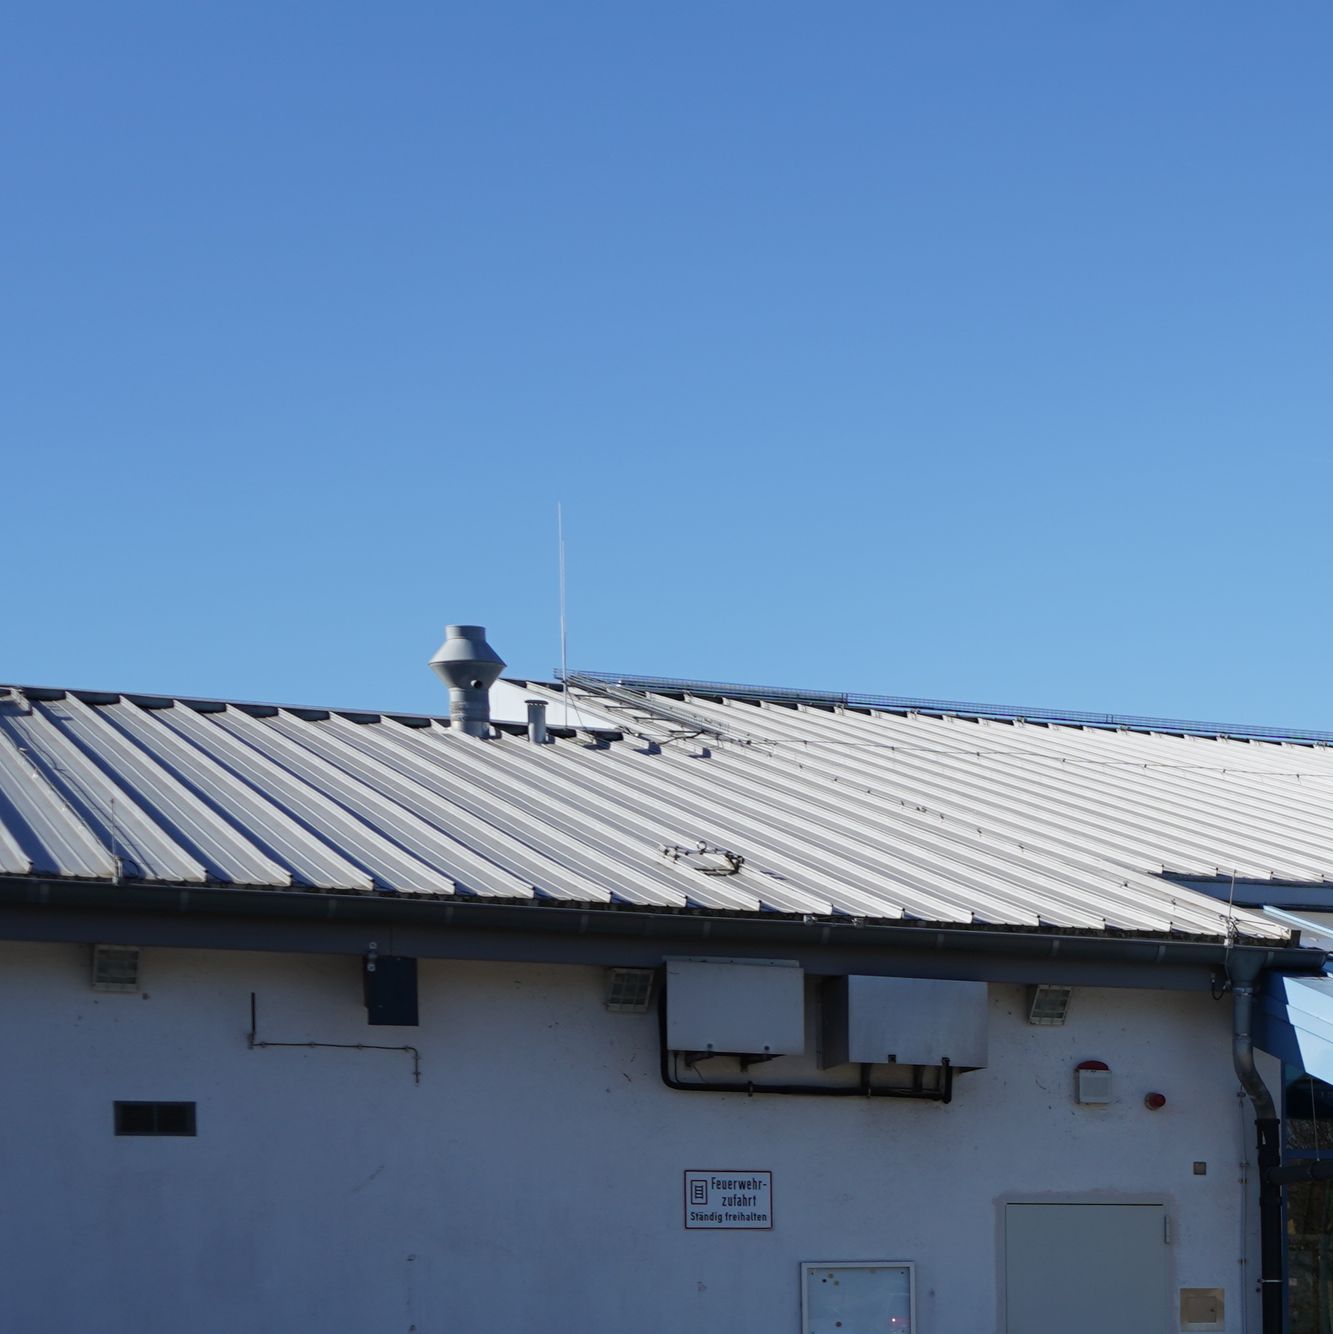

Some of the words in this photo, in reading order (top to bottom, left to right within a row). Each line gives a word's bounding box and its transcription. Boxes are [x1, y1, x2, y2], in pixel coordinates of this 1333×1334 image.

[711, 1176, 768, 1190] Feuerwehr-
[721, 1193, 757, 1207] zufahrt
[689, 1211, 723, 1223] Ständig
[725, 1211, 768, 1222] freihalten
